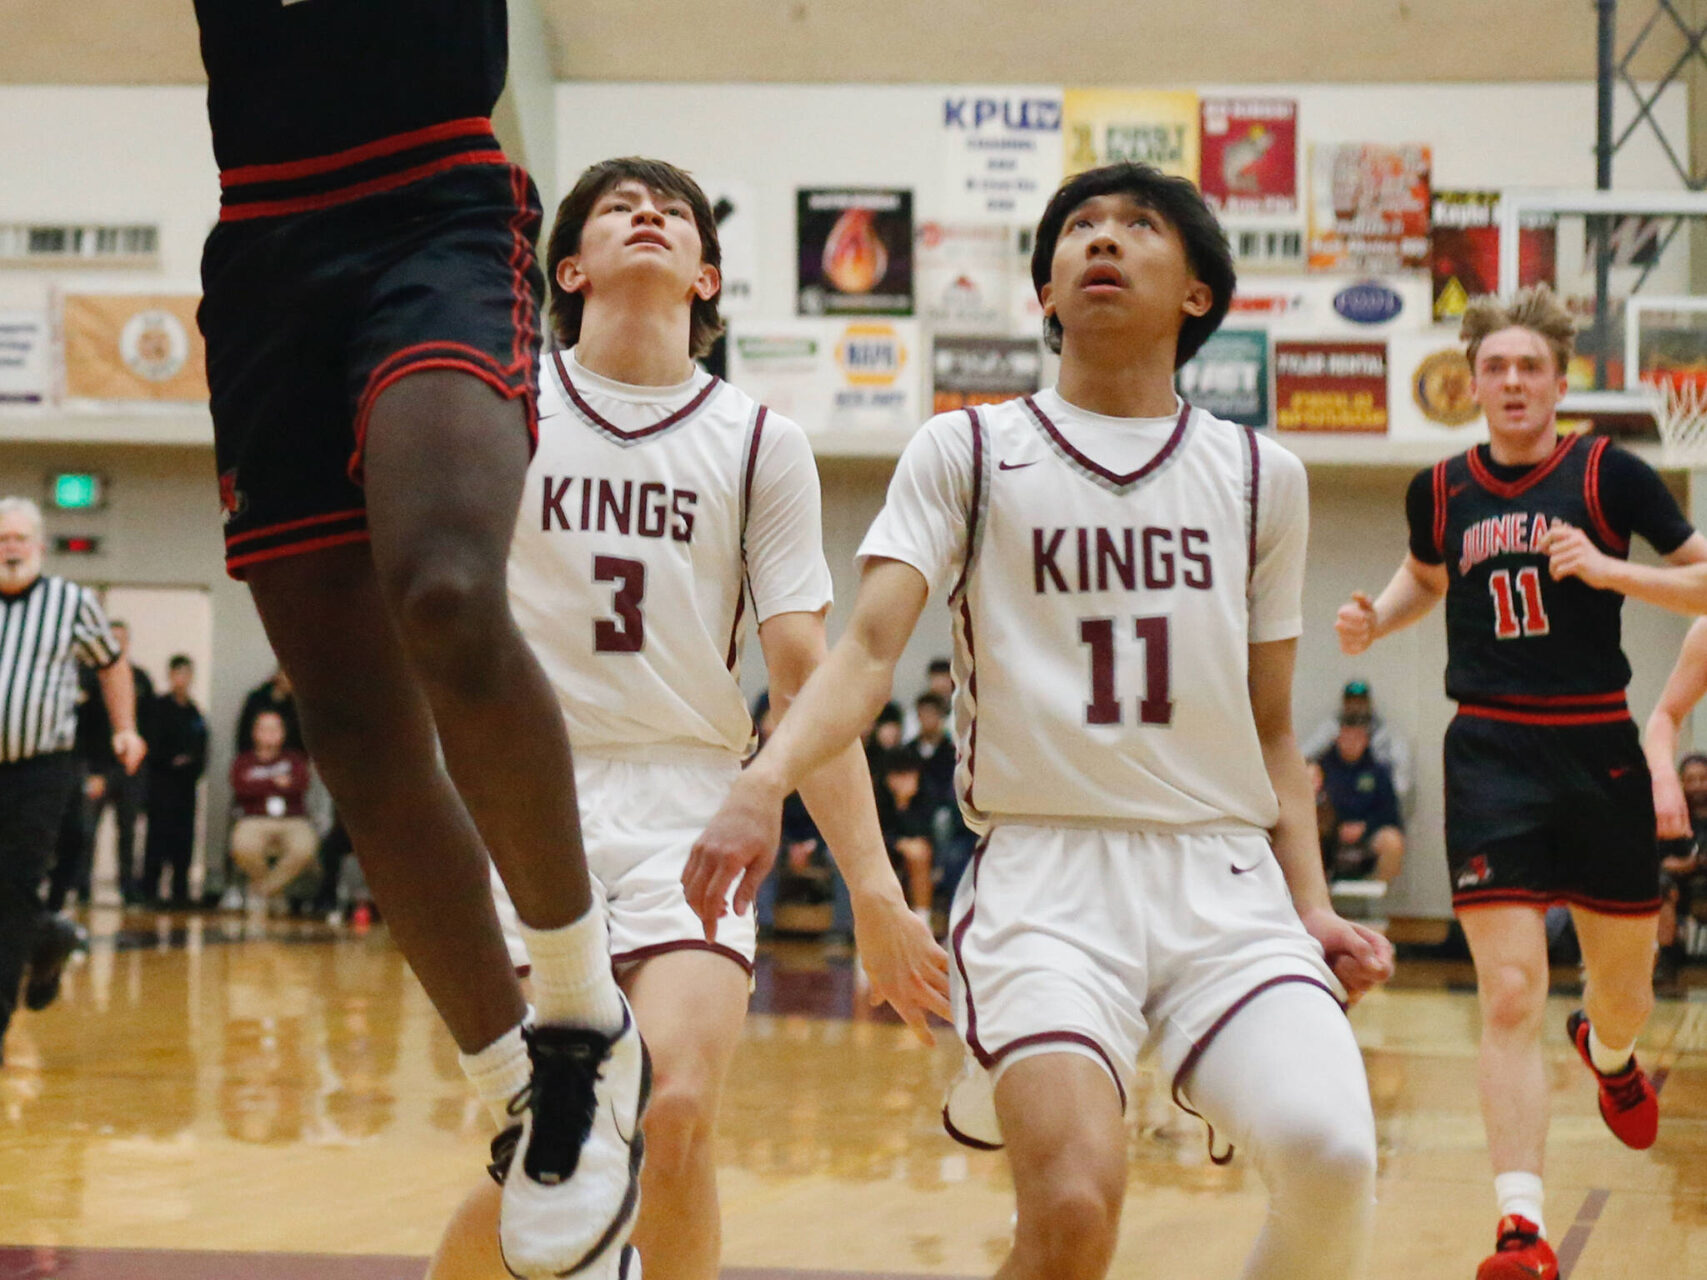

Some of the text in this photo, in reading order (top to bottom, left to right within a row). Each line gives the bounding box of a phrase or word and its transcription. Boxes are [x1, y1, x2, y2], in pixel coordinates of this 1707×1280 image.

[541, 475, 697, 543] KINGS
[1032, 526, 1213, 594] KINGS
[1459, 512, 1549, 577] JUNEA
[591, 552, 647, 655] 3
[1488, 567, 1550, 639] 11
[1078, 614, 1174, 728] 11
